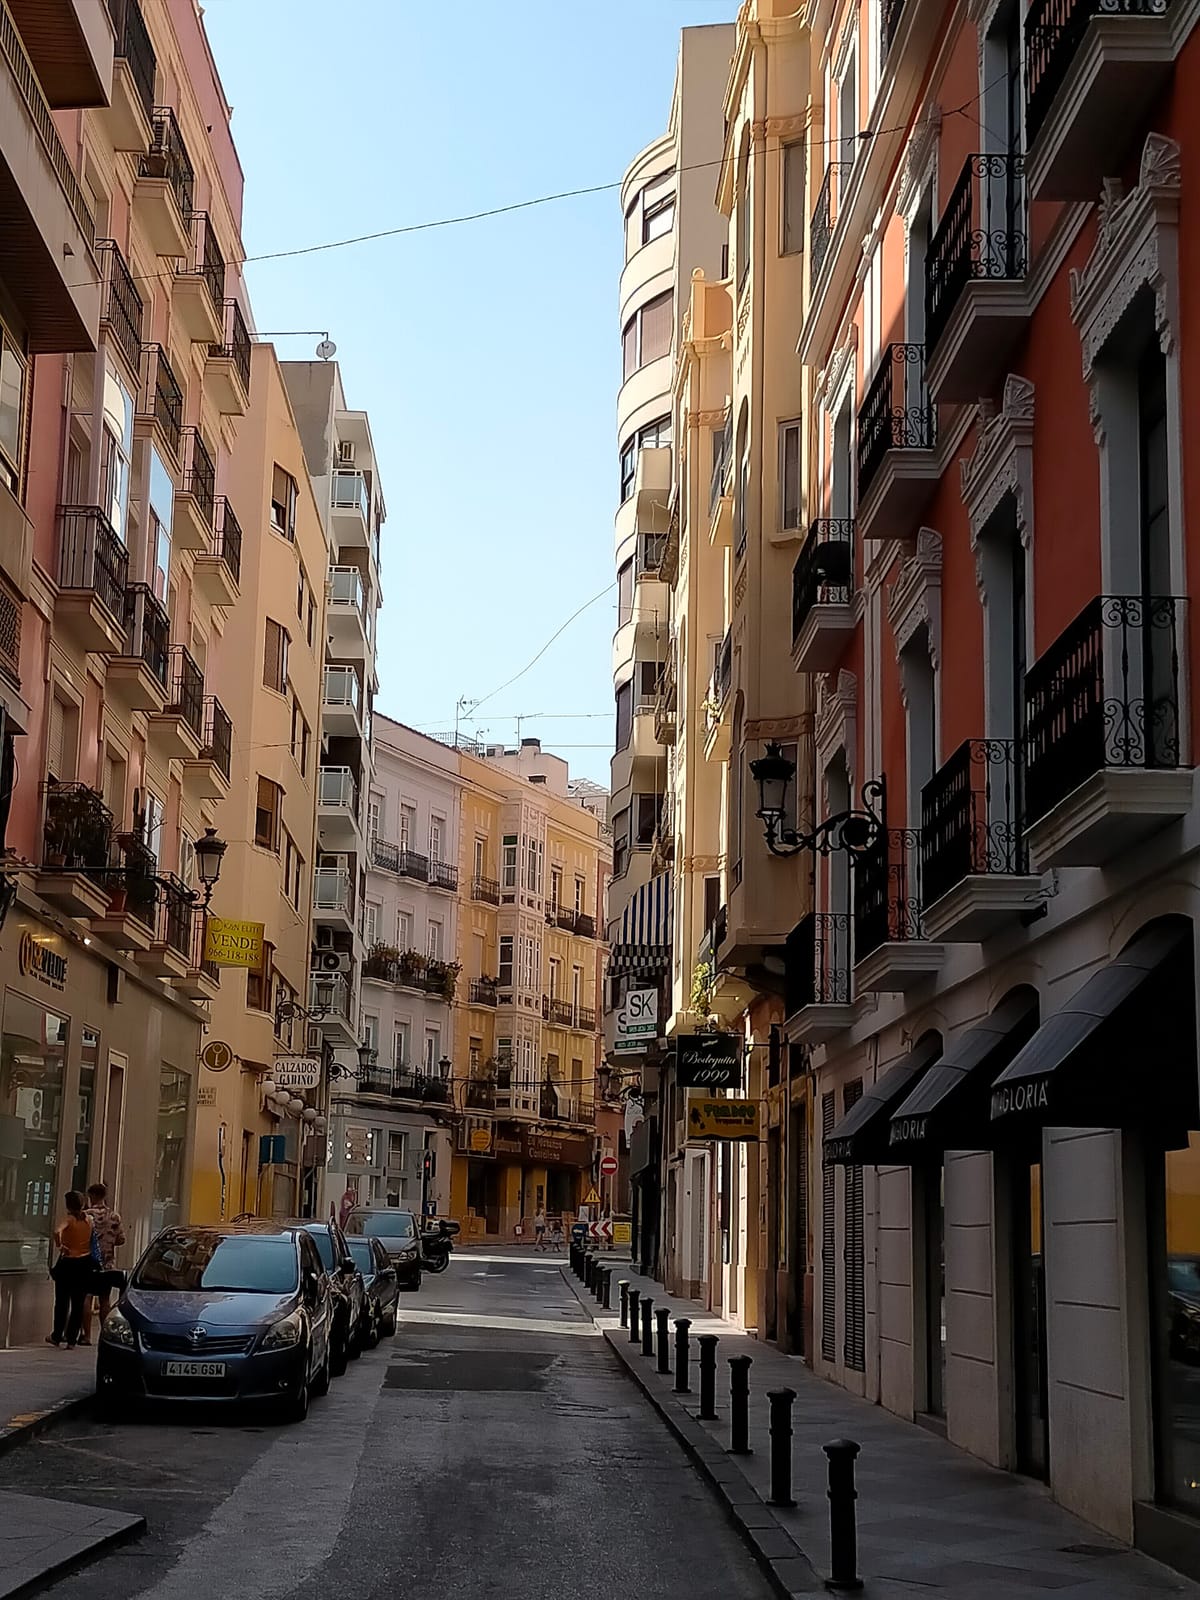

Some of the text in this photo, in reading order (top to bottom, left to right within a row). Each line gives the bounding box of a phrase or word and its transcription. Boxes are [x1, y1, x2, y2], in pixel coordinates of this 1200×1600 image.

[211, 932, 258, 951] VENDE
[630, 992, 654, 1017] SK
[617, 1011, 627, 1034] S
[275, 1062, 318, 1074] CALZADOS
[693, 1069, 730, 1082] 1999
